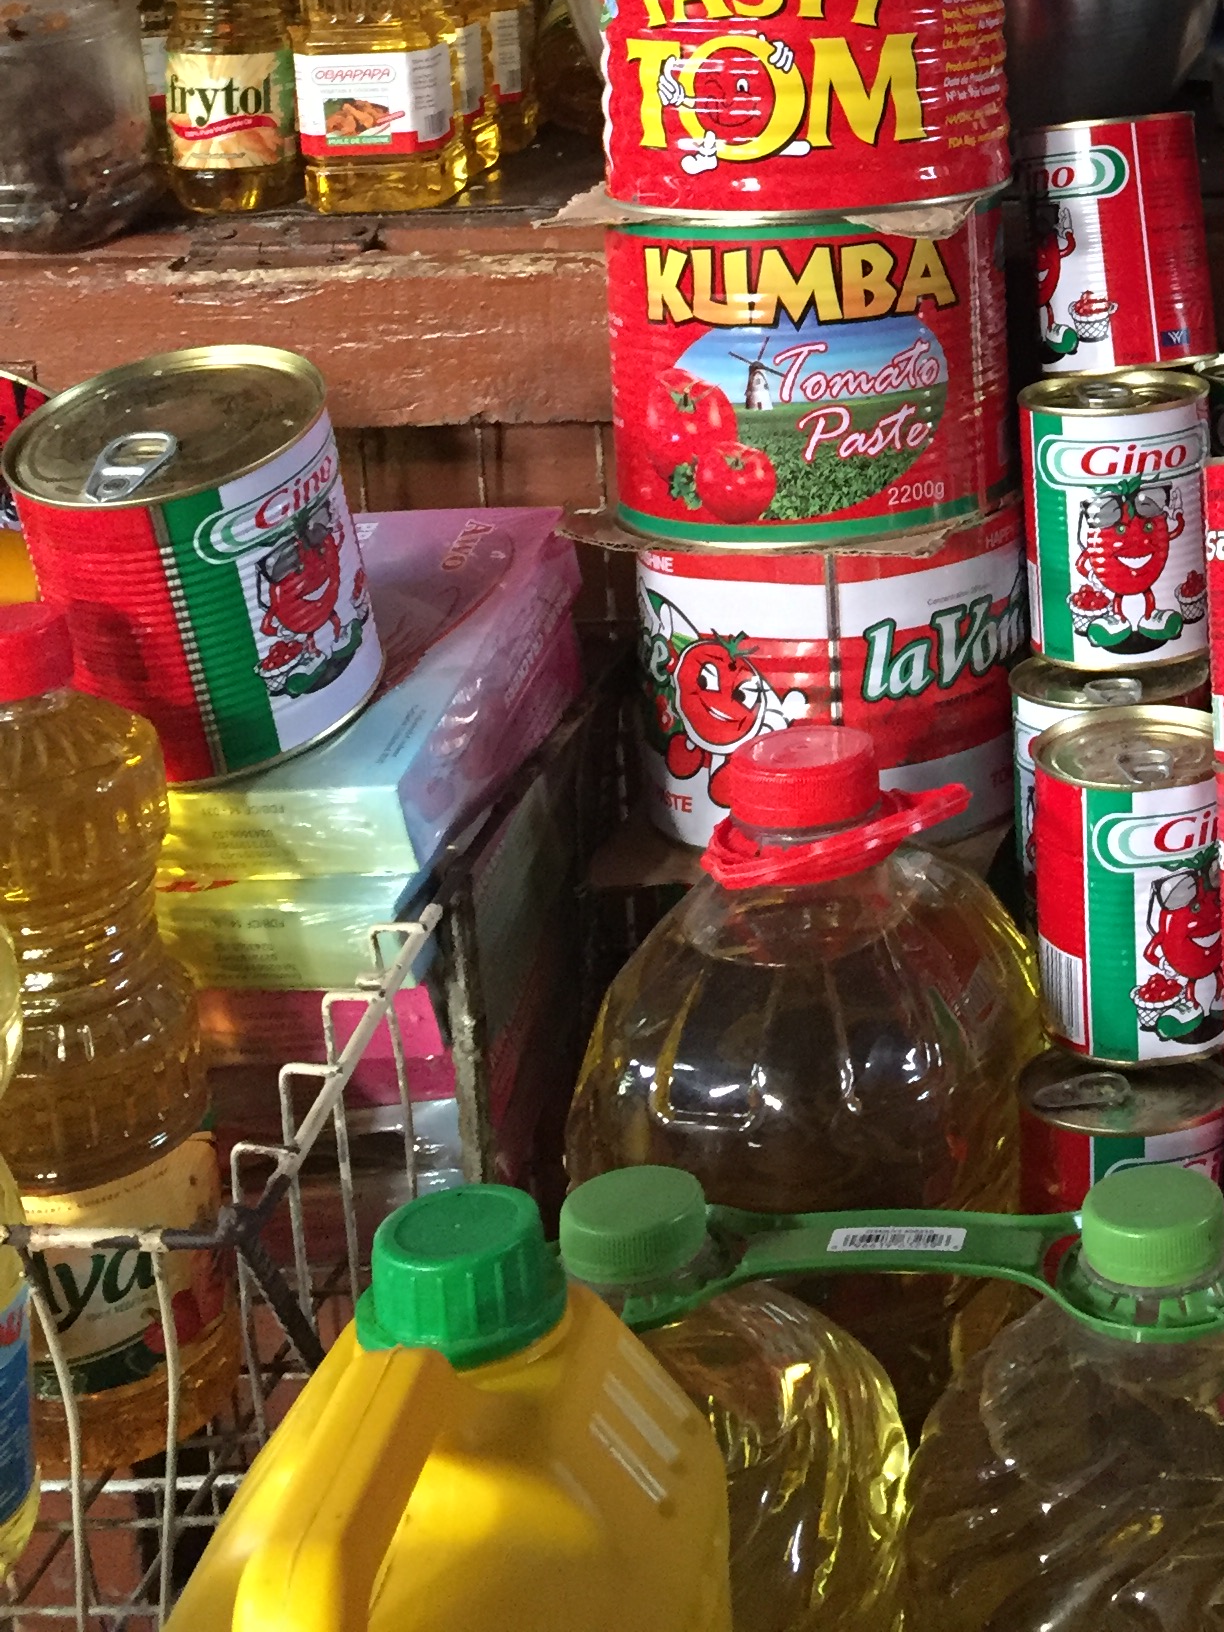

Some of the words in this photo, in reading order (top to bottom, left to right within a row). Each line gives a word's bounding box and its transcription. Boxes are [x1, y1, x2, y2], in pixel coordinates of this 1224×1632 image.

[169, 73, 274, 126] frytol
[314, 67, 391, 83] OBAAPAPA
[625, 31, 929, 162] TOM
[642, 238, 960, 331] KUMBA
[772, 337, 941, 404] Tomato
[799, 403, 931, 464] Paste
[1079, 443, 1188, 476] Gino
[253, 453, 335, 531] Gino
[886, 479, 946, 507] 2200g
